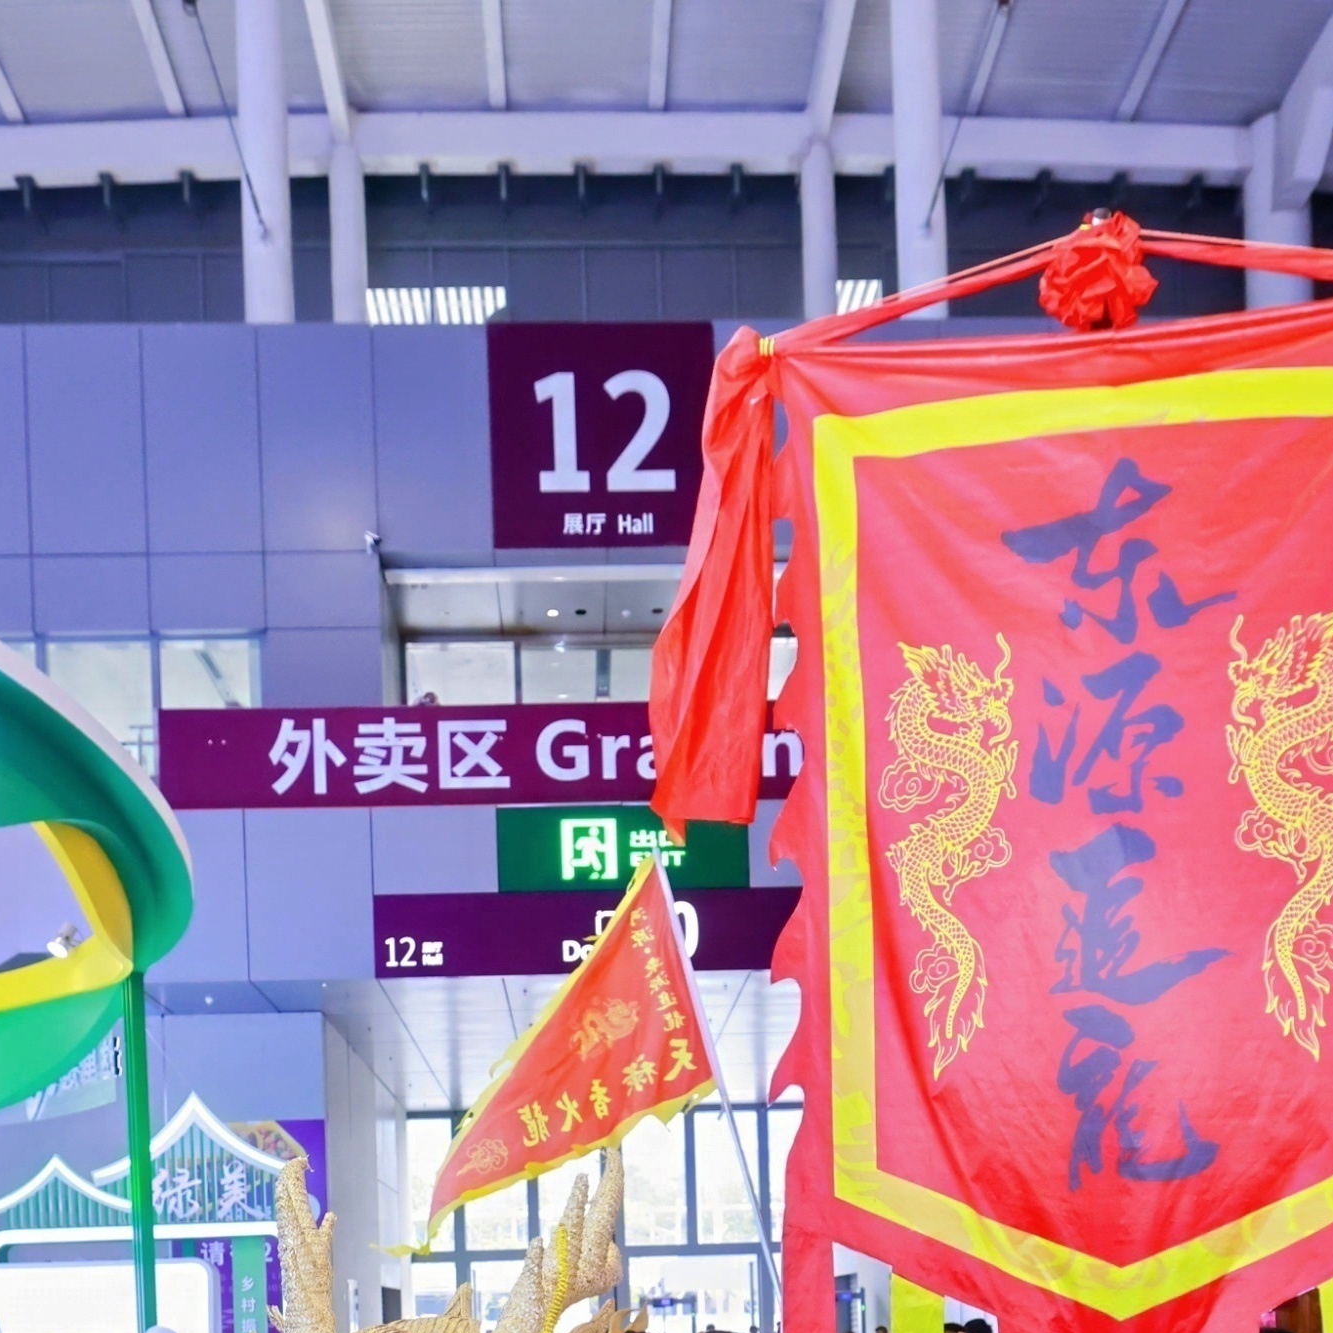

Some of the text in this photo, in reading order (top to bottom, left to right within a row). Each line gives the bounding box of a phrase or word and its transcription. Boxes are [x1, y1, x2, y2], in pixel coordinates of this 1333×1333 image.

[533, 369, 678, 494] 12
[562, 512, 655, 536] 展厅 Hall
[268, 717, 511, 796] 外卖区
[384, 936, 418, 967] 12
